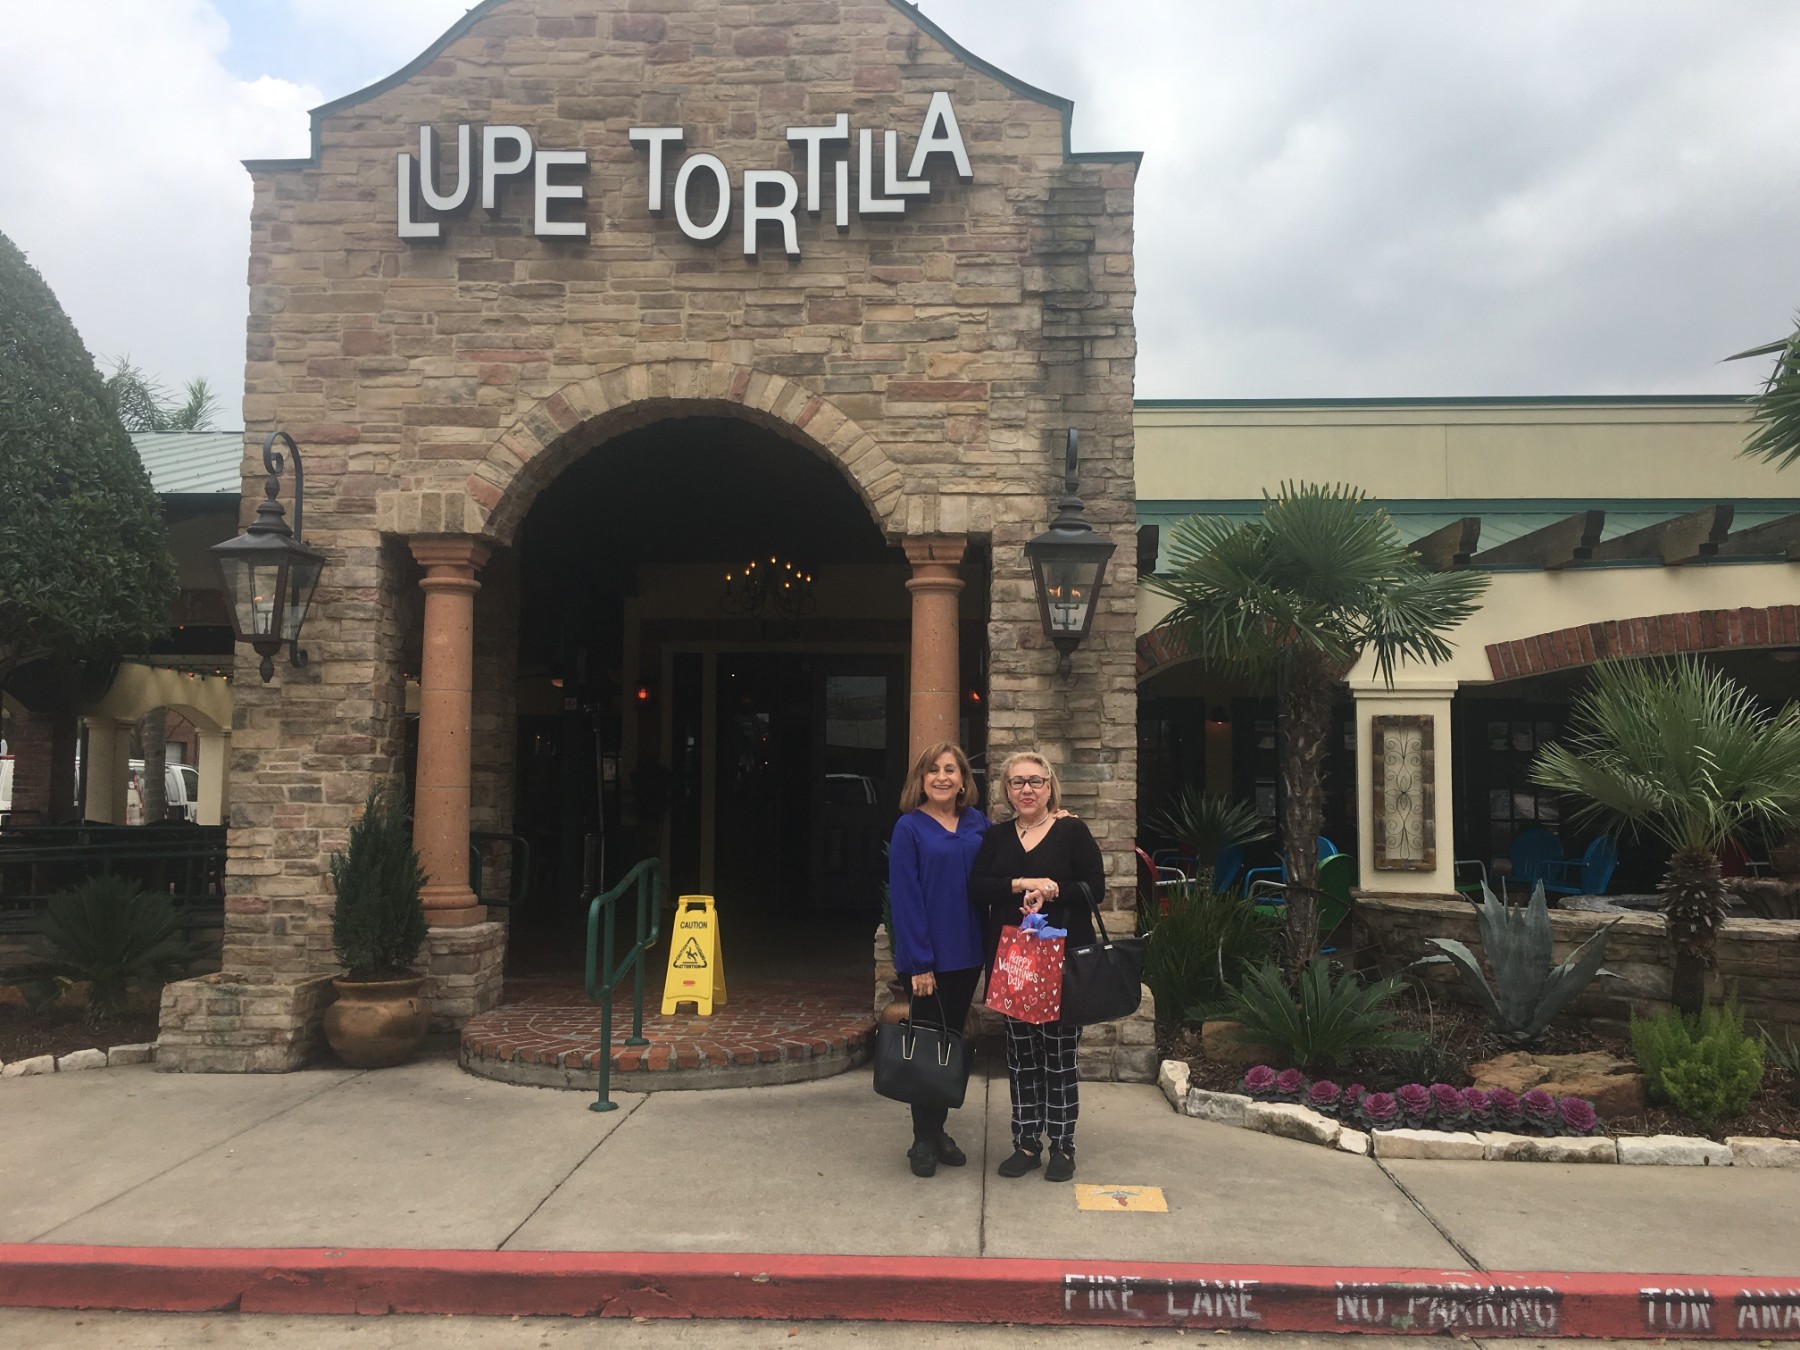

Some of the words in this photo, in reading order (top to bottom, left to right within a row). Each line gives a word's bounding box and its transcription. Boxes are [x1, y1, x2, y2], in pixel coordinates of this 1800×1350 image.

[397, 124, 588, 241] LUPE
[628, 91, 974, 259] TORTILLA
[680, 921, 707, 929] CAUTION
[1064, 1274, 1146, 1319] FIRE
[1167, 1278, 1262, 1321] LANE
[1335, 1281, 1384, 1322] NO
[1408, 1282, 1556, 1328] PARKING
[1639, 1287, 1710, 1330] TOW
